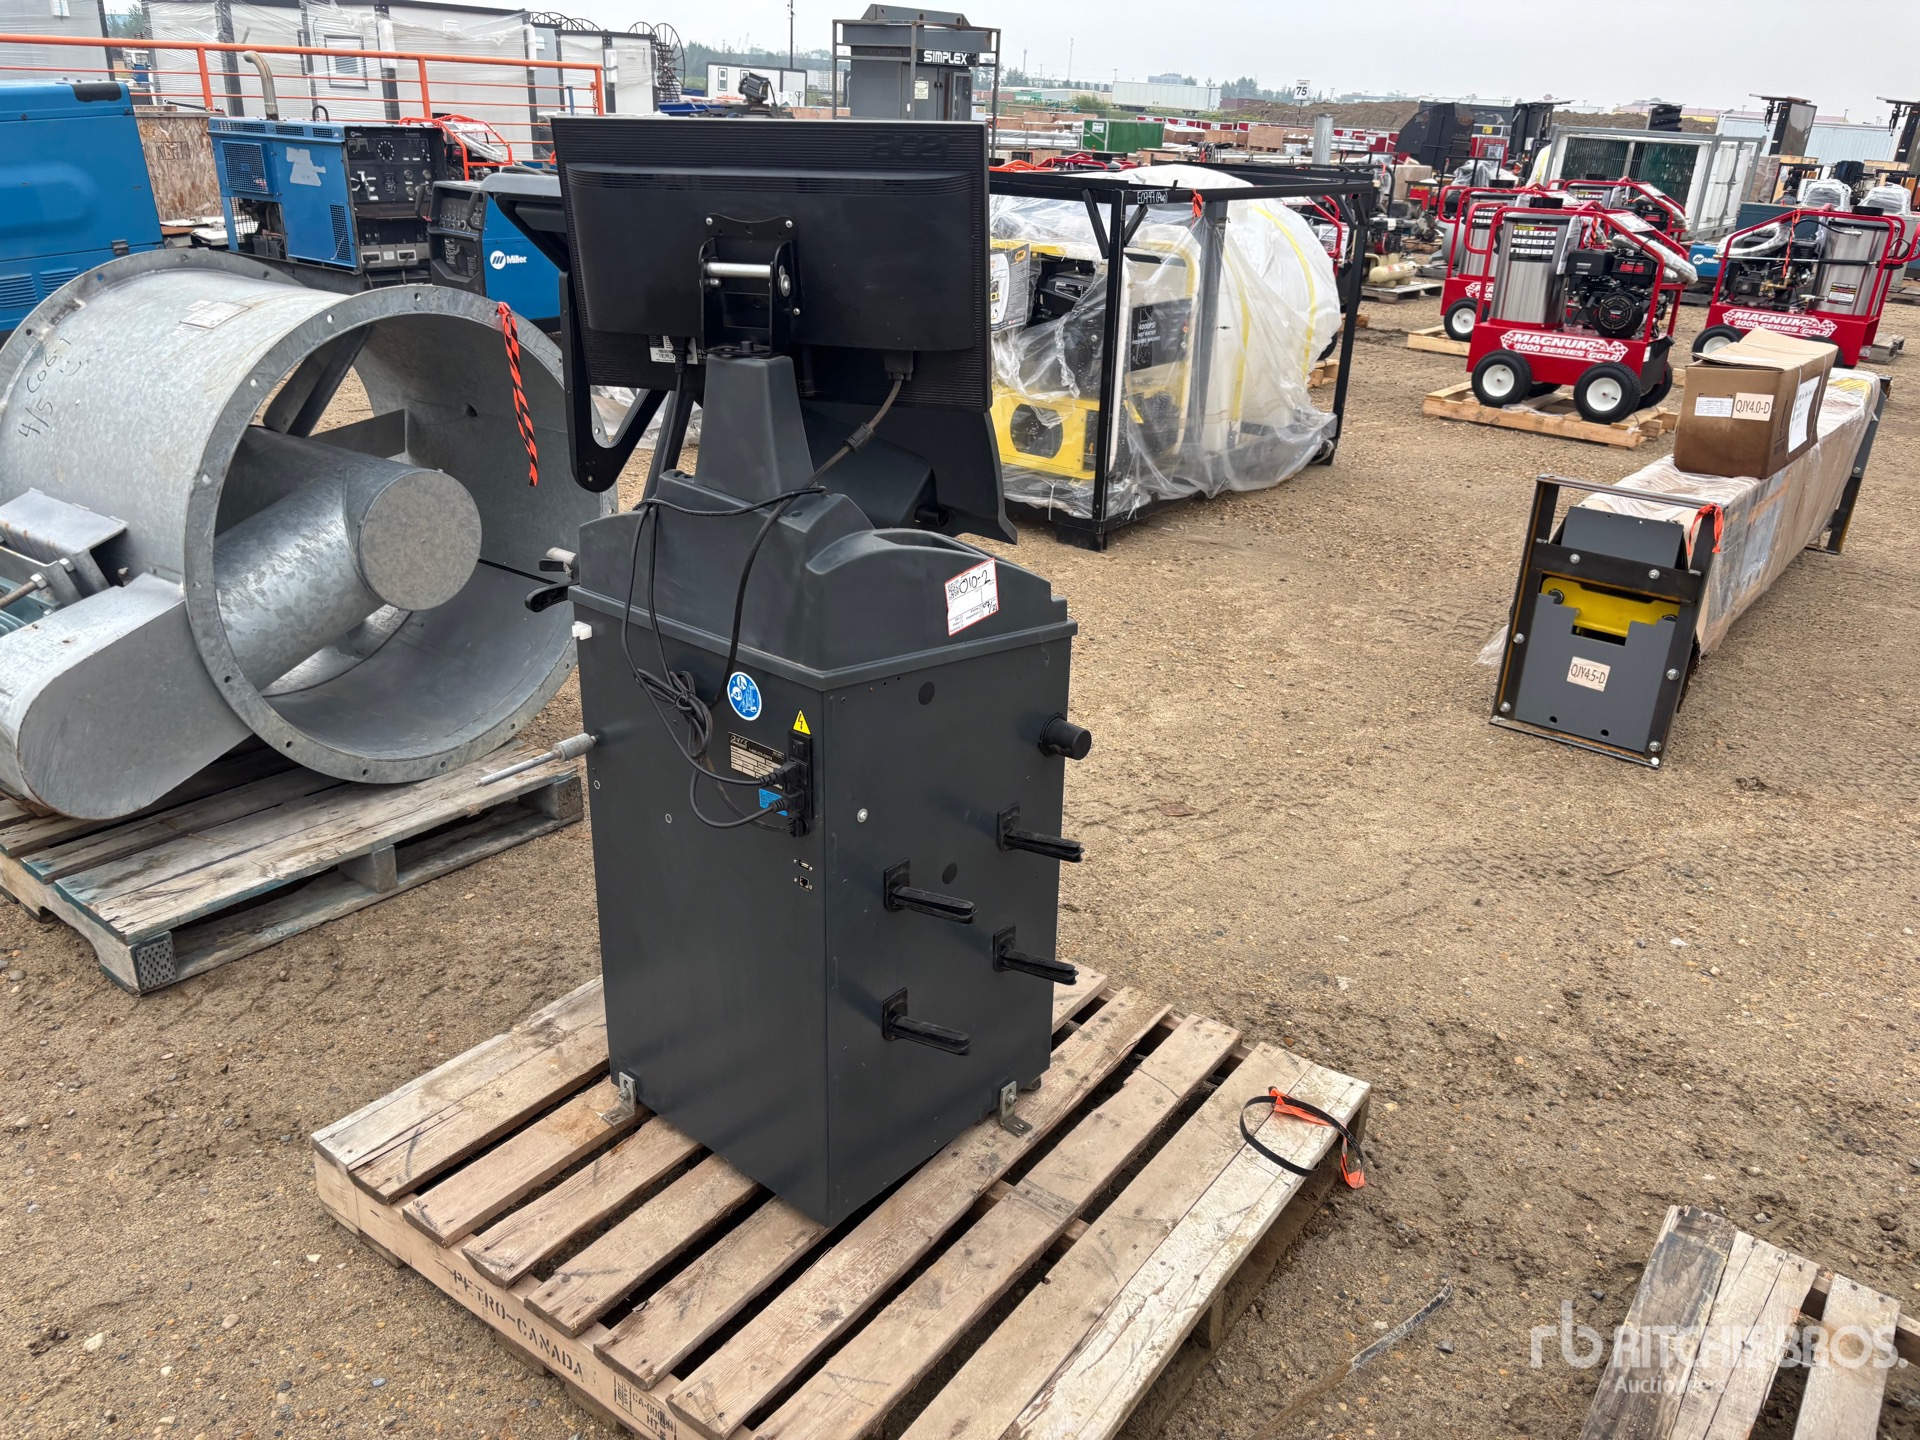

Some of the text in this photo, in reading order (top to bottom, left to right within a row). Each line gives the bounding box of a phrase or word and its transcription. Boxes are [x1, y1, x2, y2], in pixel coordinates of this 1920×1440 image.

[923, 50, 968, 65] SIMPLEX
[1296, 86, 1307, 96] 75
[506, 254, 527, 264] Miller
[1734, 312, 1808, 328] MAGNUM
[1734, 320, 1829, 336] 4000 SERIES GOLD
[1513, 333, 1594, 350] MAGNUM
[1514, 343, 1620, 361] 4000 SERIES GOLD
[1735, 399, 1771, 414] QJY4.0-D
[1570, 663, 1606, 684] QJY4.5-D
[453, 1269, 585, 1382] PETRO-CANADA
[646, 1414, 659, 1430] HT
